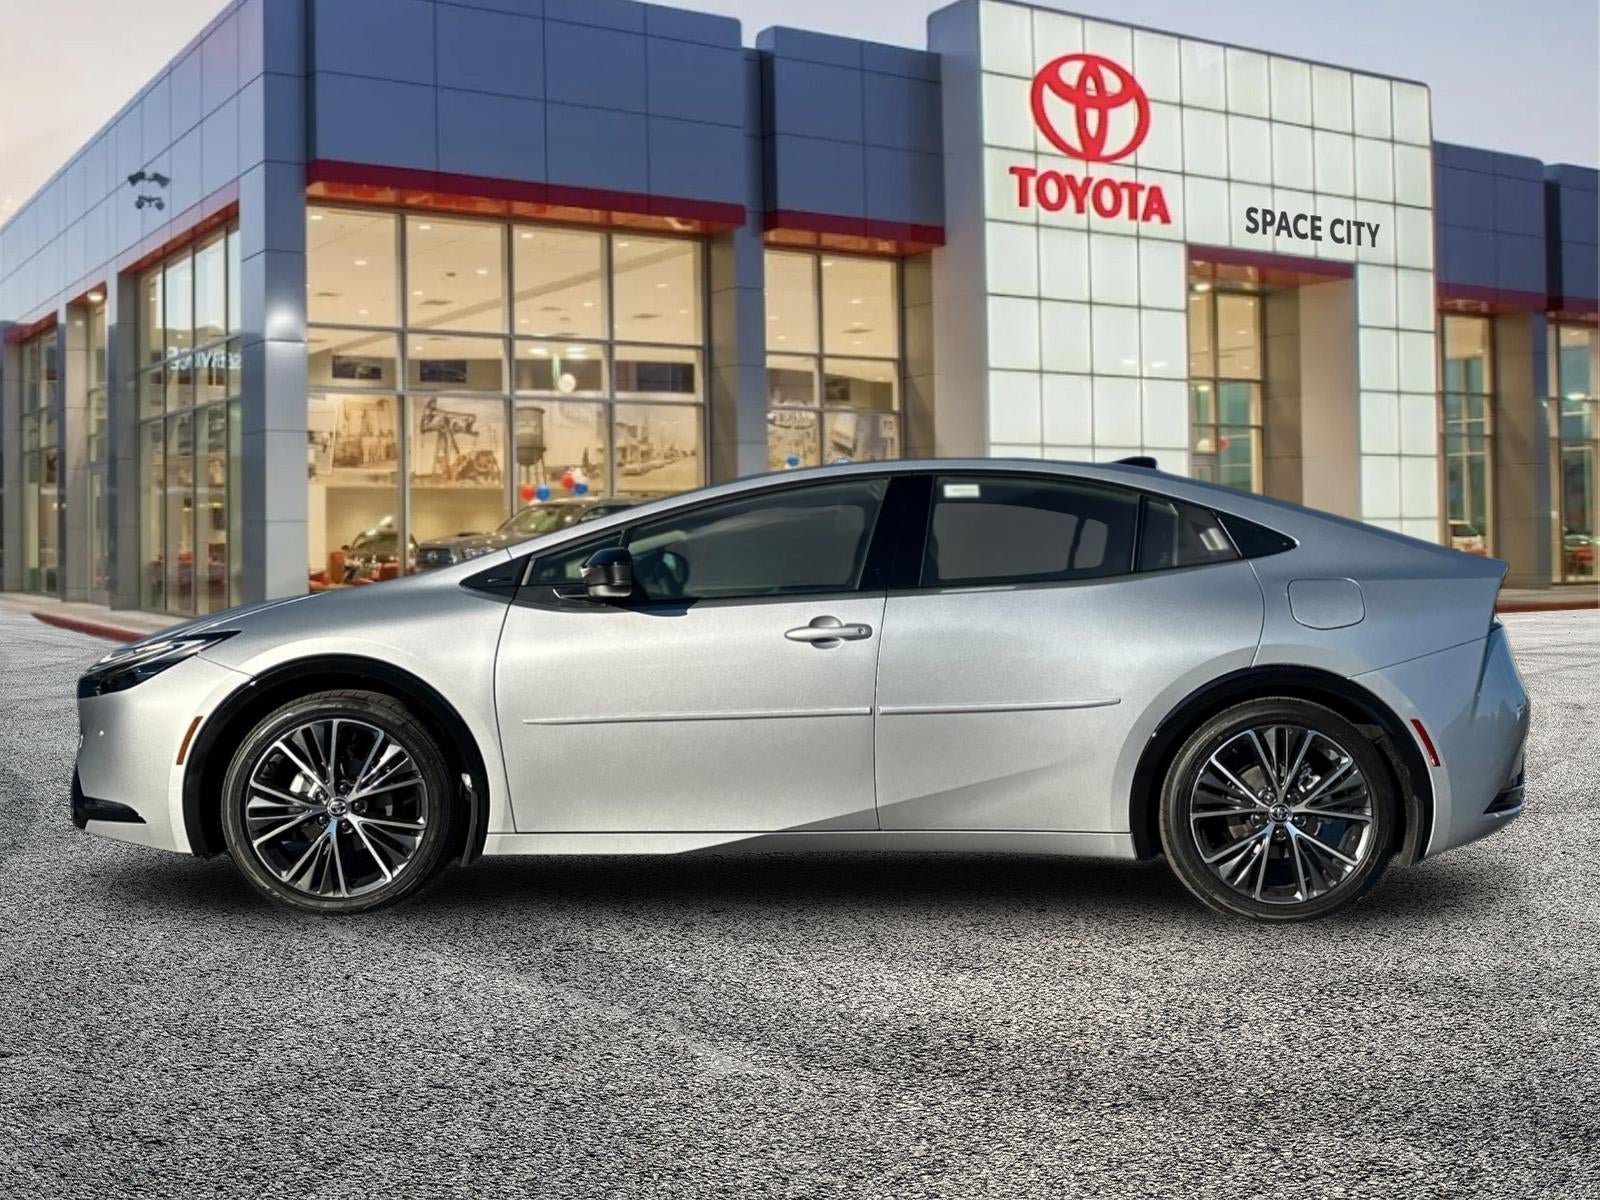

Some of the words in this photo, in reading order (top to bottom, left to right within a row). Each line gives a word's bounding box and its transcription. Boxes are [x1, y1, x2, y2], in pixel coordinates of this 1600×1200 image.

[1009, 166, 1172, 225] TOYOTA
[1245, 206, 1323, 242] SPACE
[1329, 217, 1381, 248] CITY
